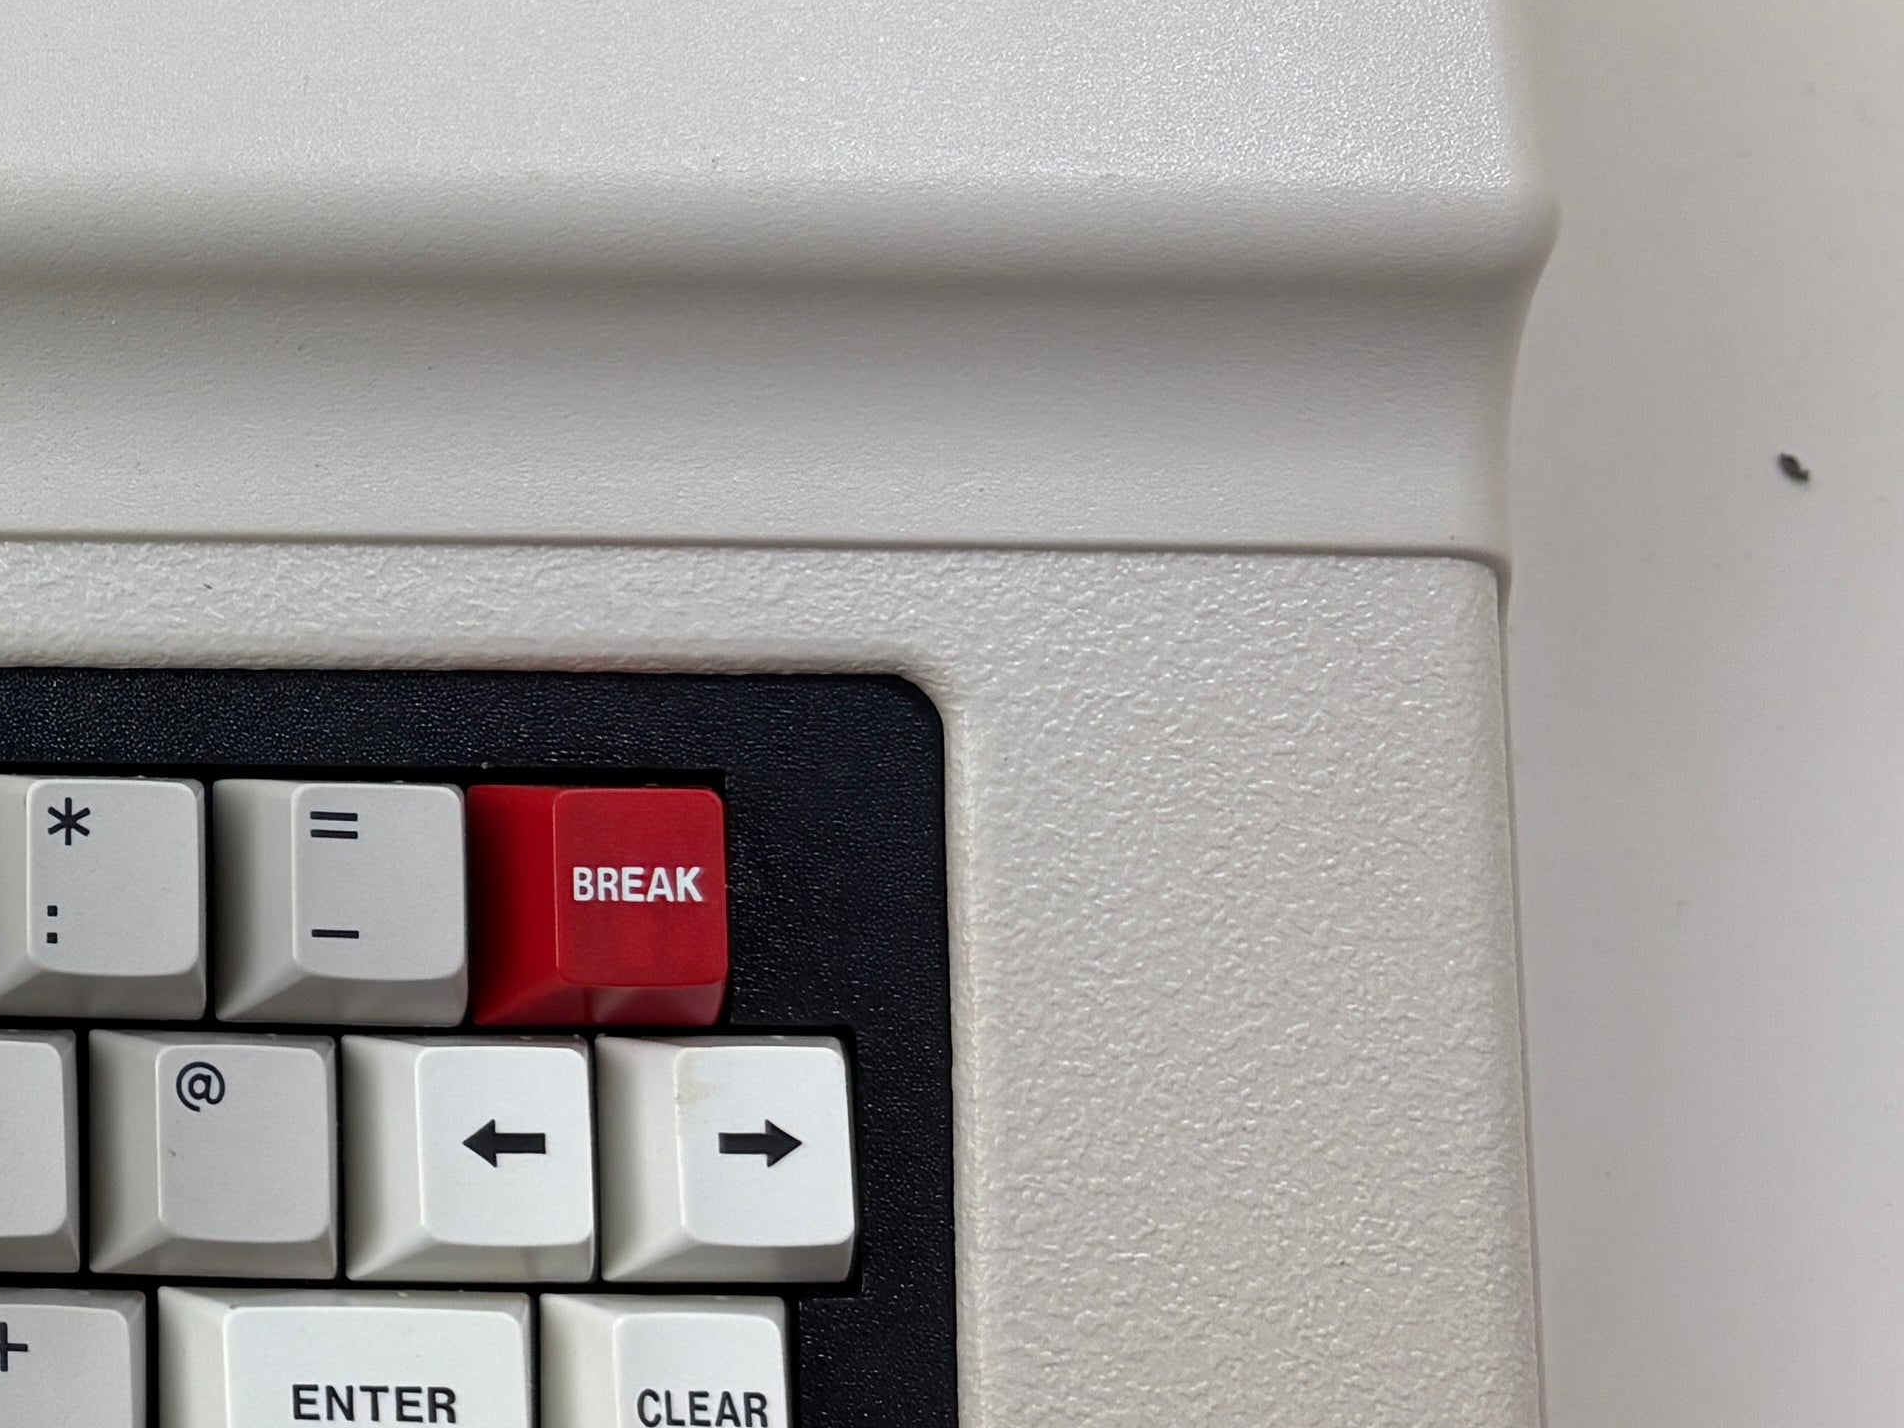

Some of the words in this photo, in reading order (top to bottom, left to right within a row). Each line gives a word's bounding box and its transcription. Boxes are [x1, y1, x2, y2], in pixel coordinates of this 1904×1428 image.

[310, 811, 358, 839] =
[574, 867, 703, 902] BREAK
[176, 1062, 225, 1112] @
[293, 1385, 456, 1423] ENTER
[638, 1389, 767, 1427] CLEAR
